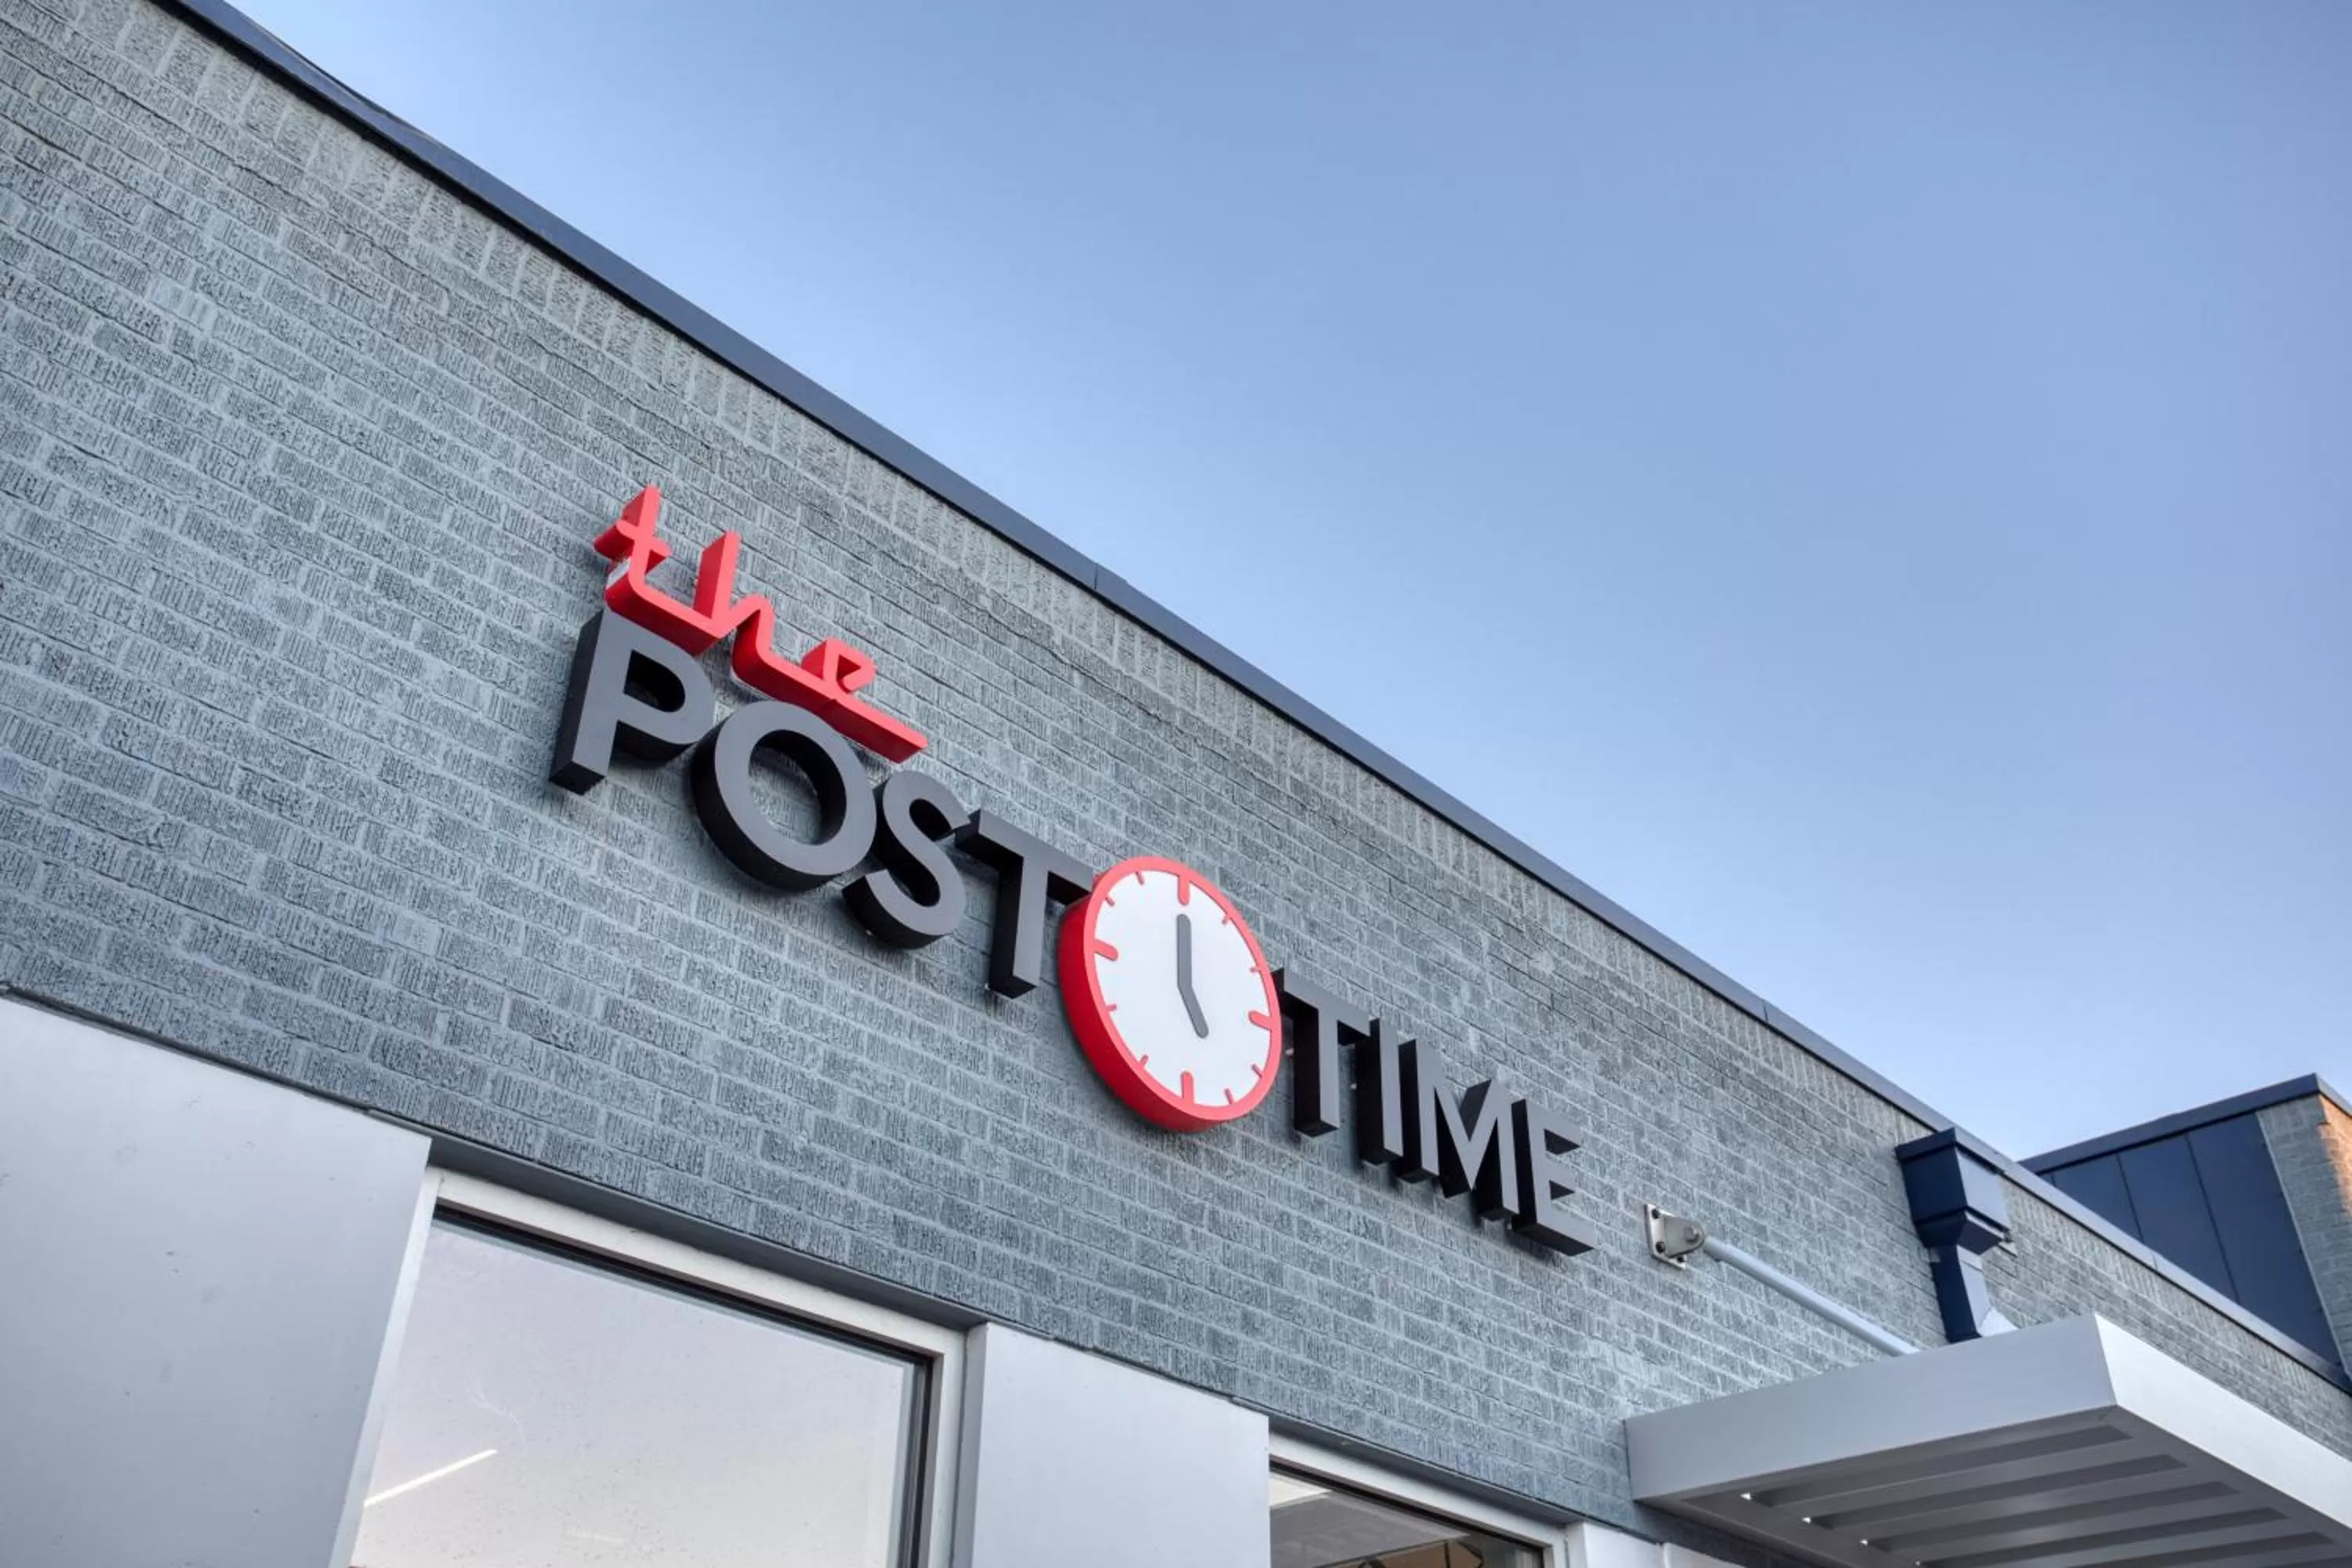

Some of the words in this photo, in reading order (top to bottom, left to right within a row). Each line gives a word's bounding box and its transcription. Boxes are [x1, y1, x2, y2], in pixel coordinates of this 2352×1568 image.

[593, 485, 929, 764] the
[549, 609, 1099, 1000] POST
[1273, 967, 1595, 1256] TIME
